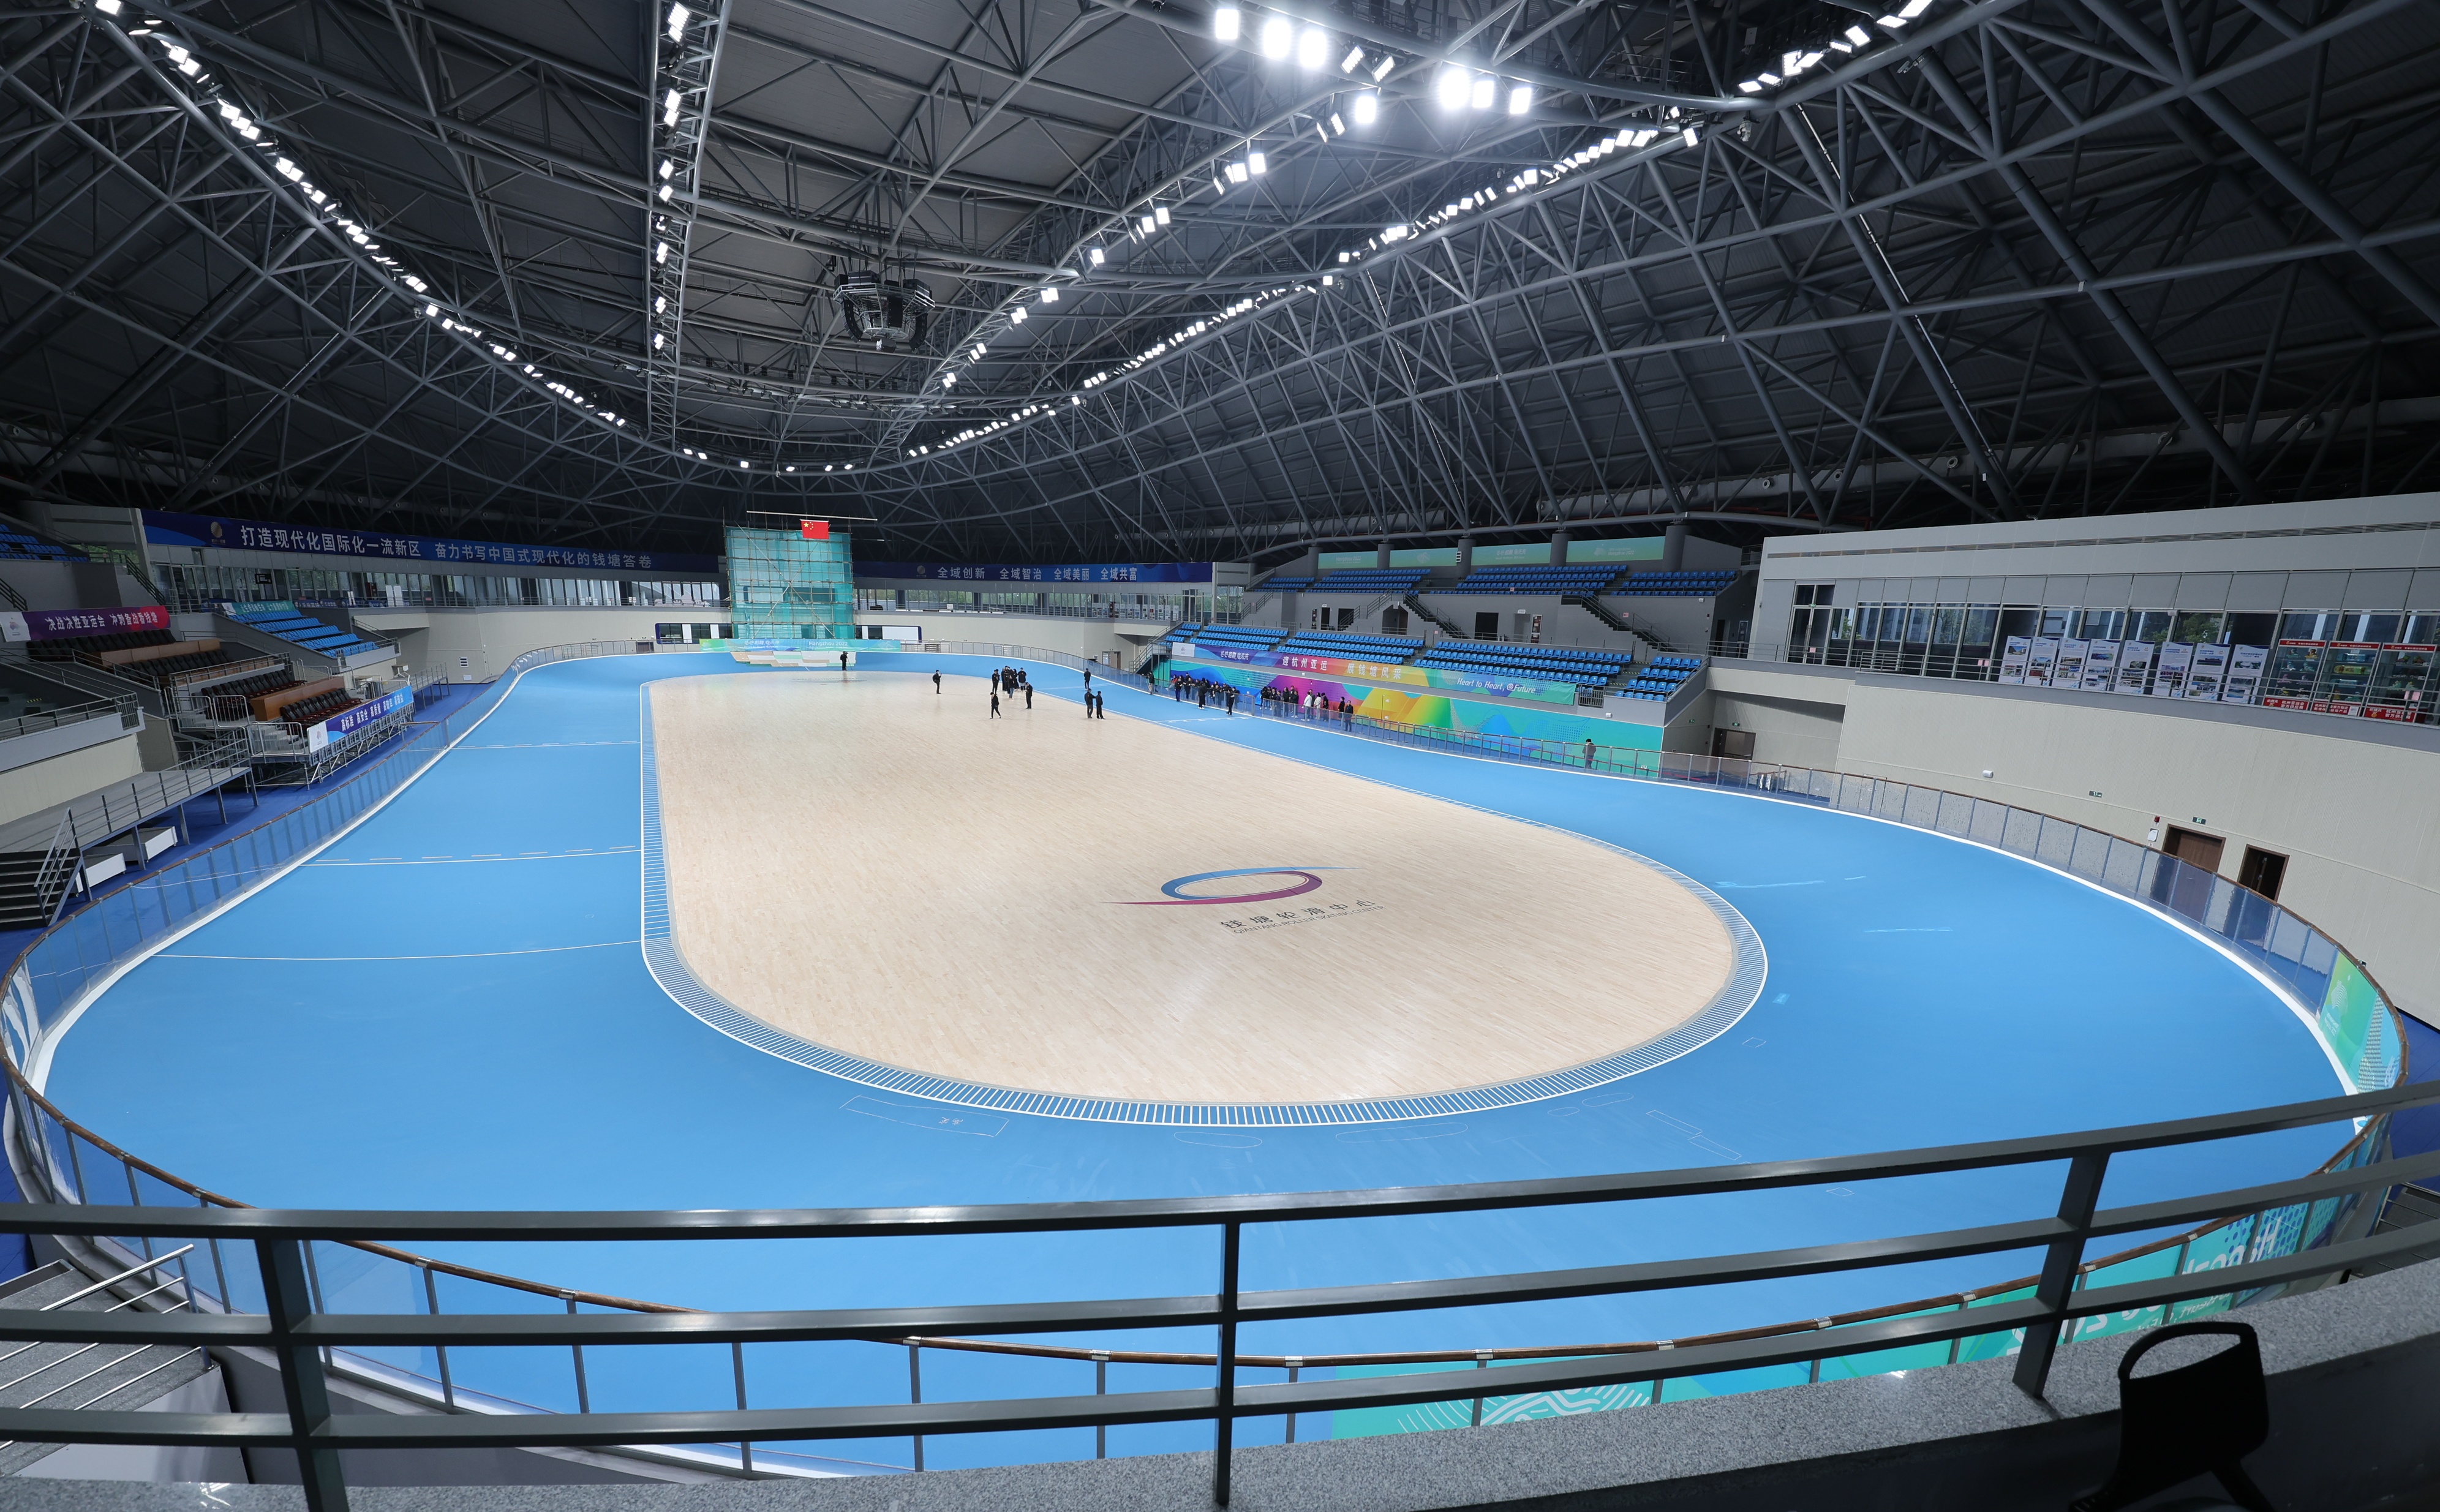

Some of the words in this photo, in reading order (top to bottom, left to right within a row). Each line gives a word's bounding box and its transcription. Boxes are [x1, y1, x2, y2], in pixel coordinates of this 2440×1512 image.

[241, 525, 421, 557] 打造现代化国际化一流新区
[435, 542, 652, 568] 奋力书写中国式现代化的钱塘答卷
[937, 566, 985, 579] 全域创新
[1000, 568, 1042, 580] 全域智治
[1053, 568, 1090, 581] 全域美丽
[1101, 566, 1137, 581] 全域共富
[45, 614, 105, 631] 决战决胜亚运会
[109, 611, 158, 626] 冲刺备战看钱塘
[1282, 656, 1328, 671] 迎杭州亚运
[1347, 663, 1402, 679] 展钱塘风采
[1457, 678, 1474, 686] Heart
[1485, 681, 1505, 692] Heart,
[1507, 683, 1536, 693] @Future
[341, 715, 355, 731] 高标准
[356, 709, 369, 725] 高安全
[369, 703, 382, 718] 高质量
[1221, 900, 1376, 928] 钱塘轮滑中心
[1233, 922, 1282, 934] QIANTANG
[1281, 916, 1316, 925] ROLLER
[1315, 909, 1353, 920] SKATING
[1352, 905, 1387, 916] CENTER
